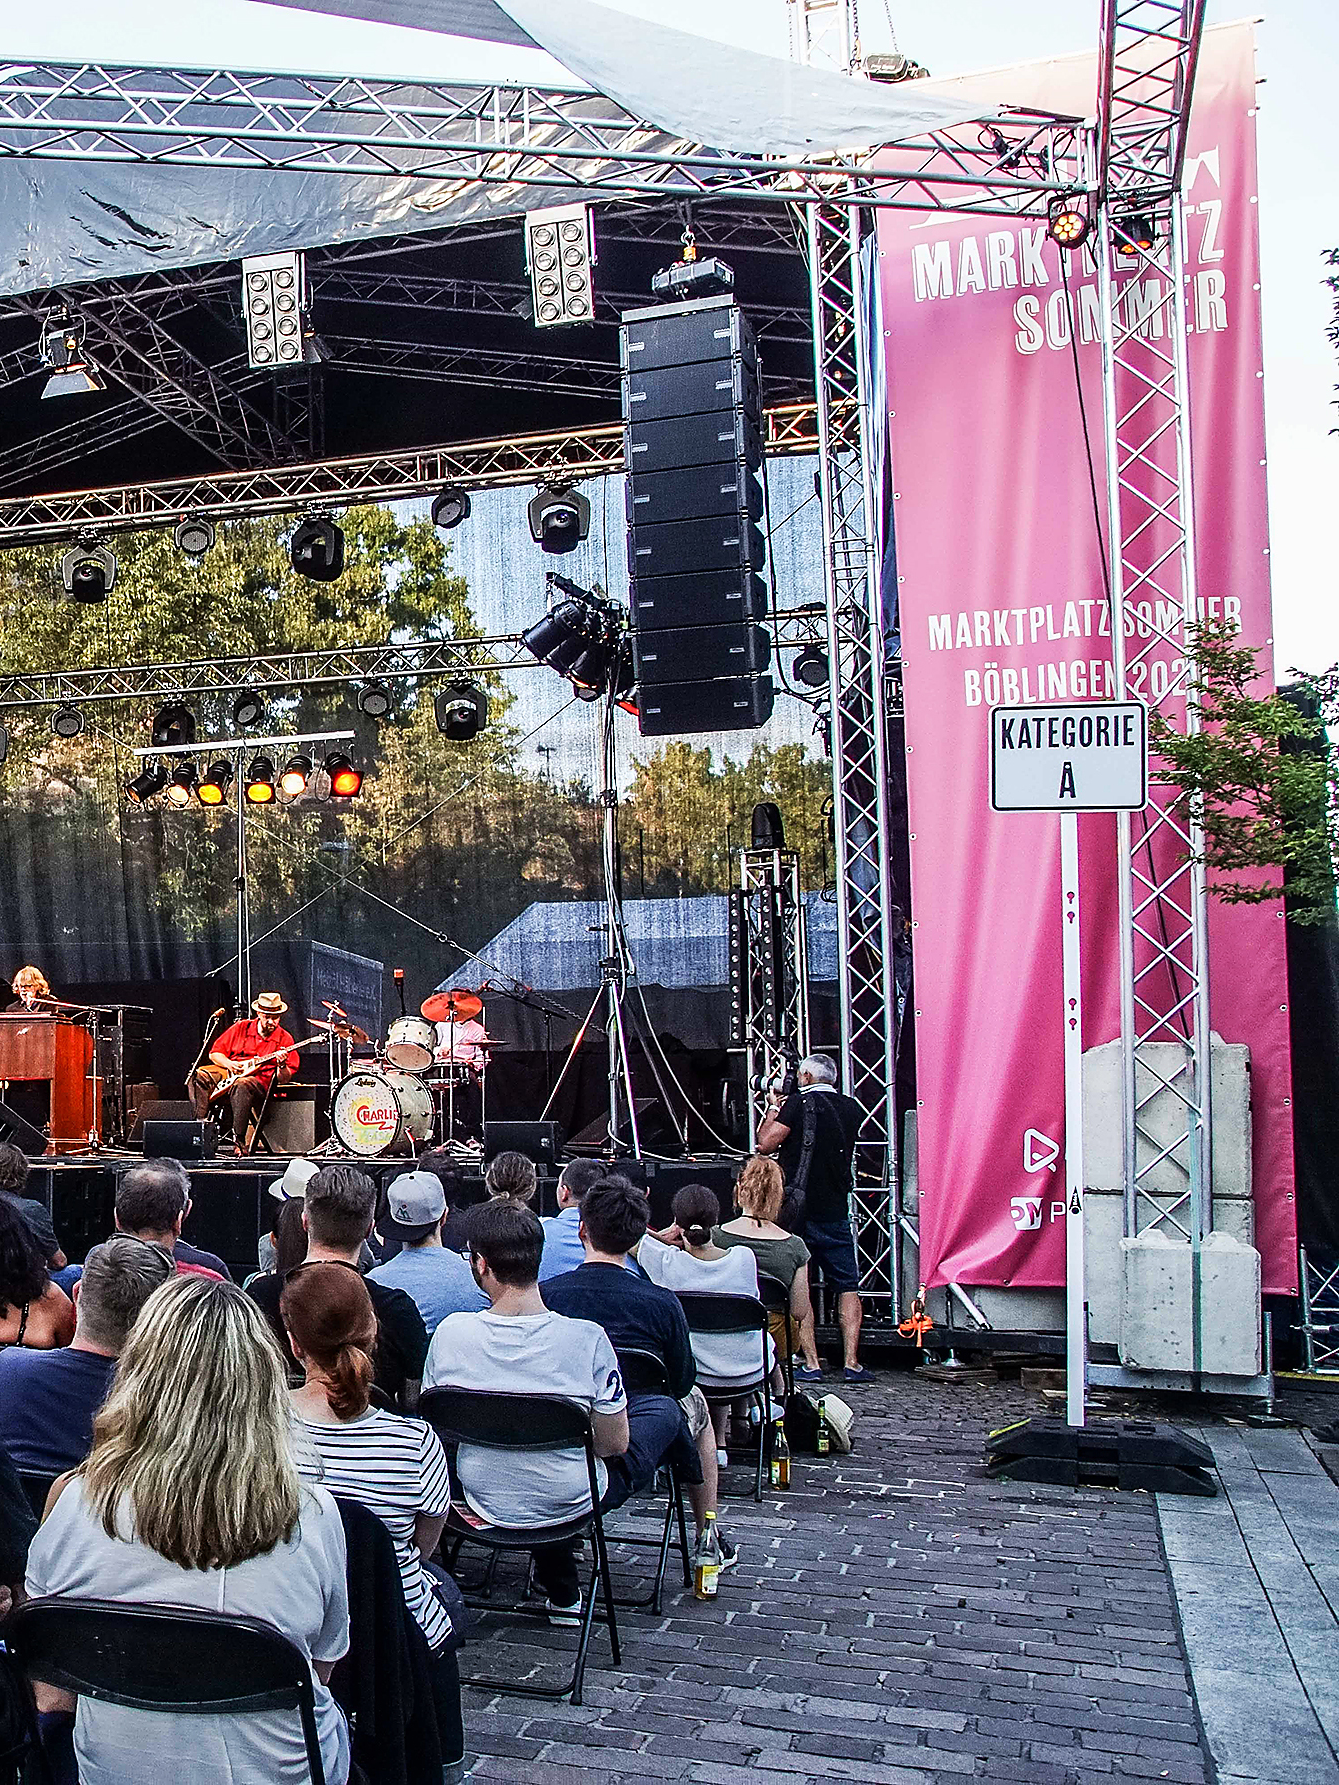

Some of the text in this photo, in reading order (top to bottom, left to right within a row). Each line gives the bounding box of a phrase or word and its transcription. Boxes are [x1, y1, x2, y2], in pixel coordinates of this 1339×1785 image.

[928, 599, 1112, 651] MARKTPLATZ
[964, 658, 1209, 707] BÖBLINGEN 202
[1001, 714, 1135, 750] KATEGORIE
[1059, 761, 1077, 799] A
